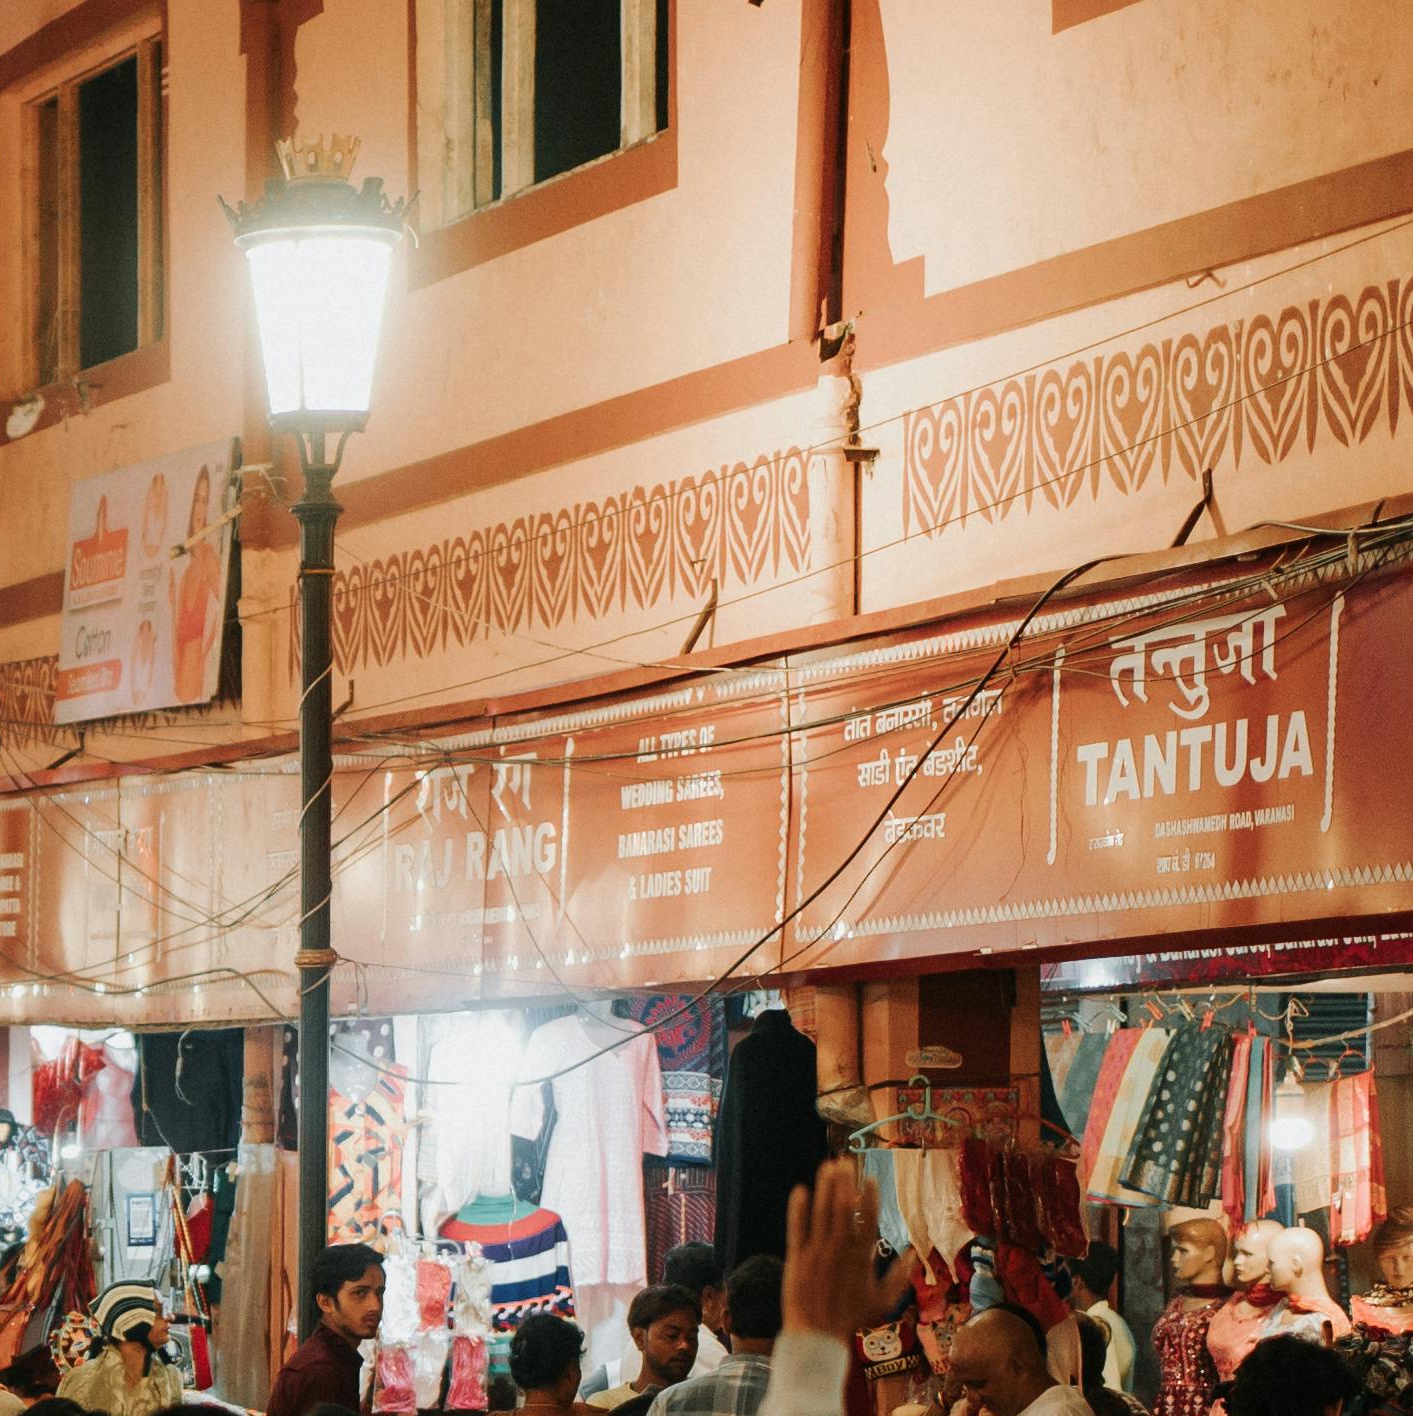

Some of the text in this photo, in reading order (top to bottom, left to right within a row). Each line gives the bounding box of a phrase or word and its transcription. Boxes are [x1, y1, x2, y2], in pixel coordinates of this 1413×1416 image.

[1108, 604, 1287, 721] तन्तुजा
[637, 725, 716, 764] ALL TYPES OF
[1076, 710, 1314, 807] TANTUJA
[620, 779, 674, 810] WEDDING
[1229, 811, 1254, 832] ROAD,
[1254, 804, 1295, 828] VARANASI
[394, 821, 557, 891] RAJ RANG
[617, 819, 724, 860] BANARASI SAREES
[640, 869, 682, 899] LADIES
[684, 867, 712, 895] SUIT
